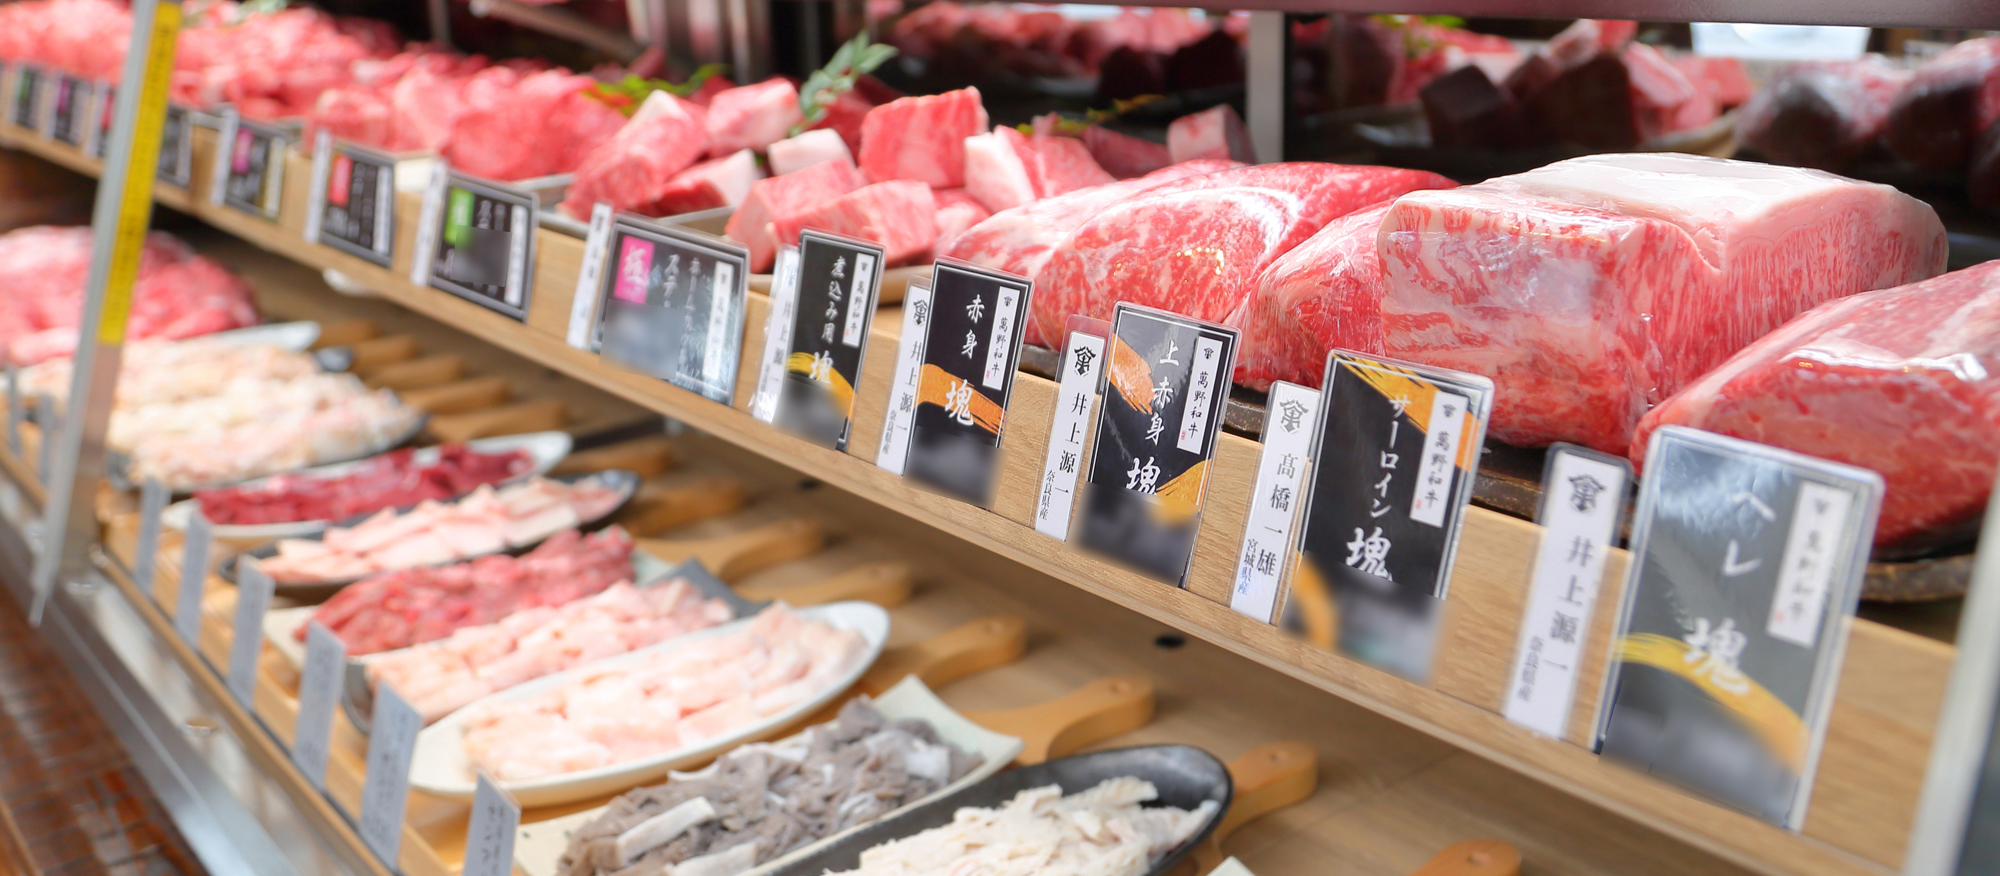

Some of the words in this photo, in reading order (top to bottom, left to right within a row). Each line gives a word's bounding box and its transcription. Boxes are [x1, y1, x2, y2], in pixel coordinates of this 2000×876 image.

[820, 255, 847, 344] 煮込み用
[961, 294, 986, 359] 赤身
[896, 340, 922, 431] 井上源一
[991, 317, 1010, 378] 萬野和牛
[944, 378, 975, 426] 塊
[1144, 340, 1180, 446] 上赤身
[1188, 371, 1210, 438] 萬野和牛
[1054, 392, 1088, 494] 井上源一
[1126, 456, 1161, 495] 塊
[1369, 394, 1413, 518] サーロイン
[1424, 431, 1451, 508] 萬野和牛
[1038, 469, 1055, 521] 奈良県産
[1723, 491, 1777, 577] ヘレ
[1345, 526, 1393, 582] 塊
[1544, 534, 1594, 671] 井上源一
[1681, 616, 1751, 695] 塊
